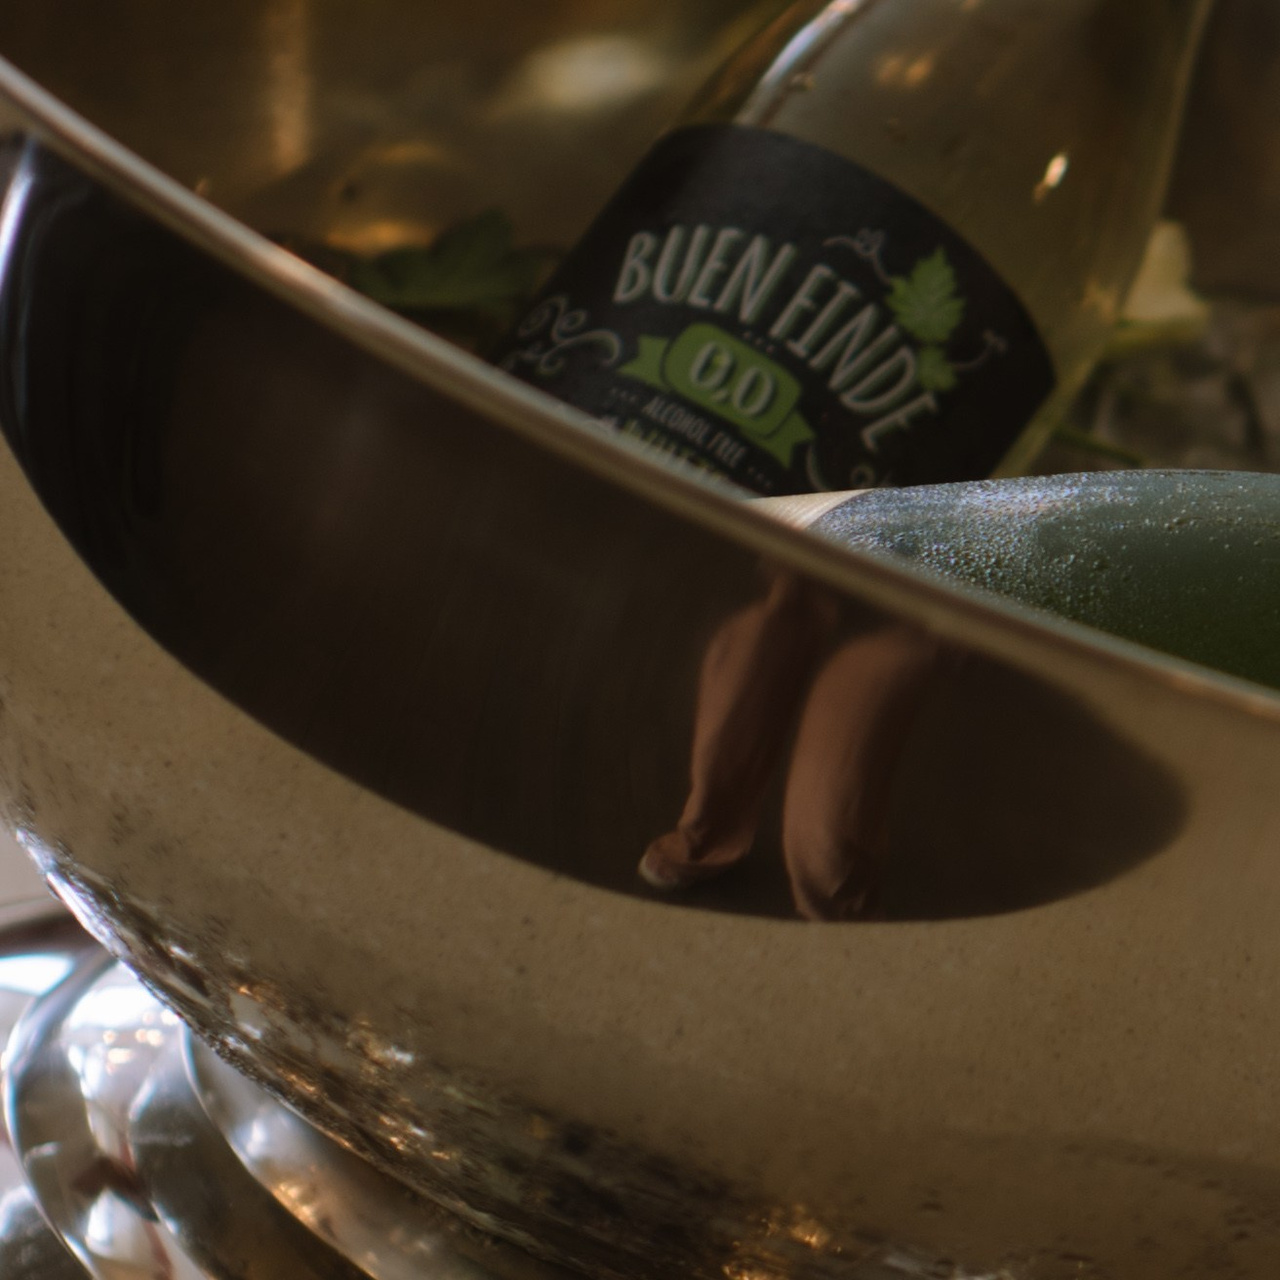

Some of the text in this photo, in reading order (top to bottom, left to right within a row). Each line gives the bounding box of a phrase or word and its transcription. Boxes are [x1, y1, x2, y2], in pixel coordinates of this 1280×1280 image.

[613, 223, 798, 322] BUEN
[768, 263, 938, 452] FINDE
[688, 340, 778, 418] 0,0
[641, 396, 711, 445] ALCOHOL
[706, 431, 747, 468] FREE
